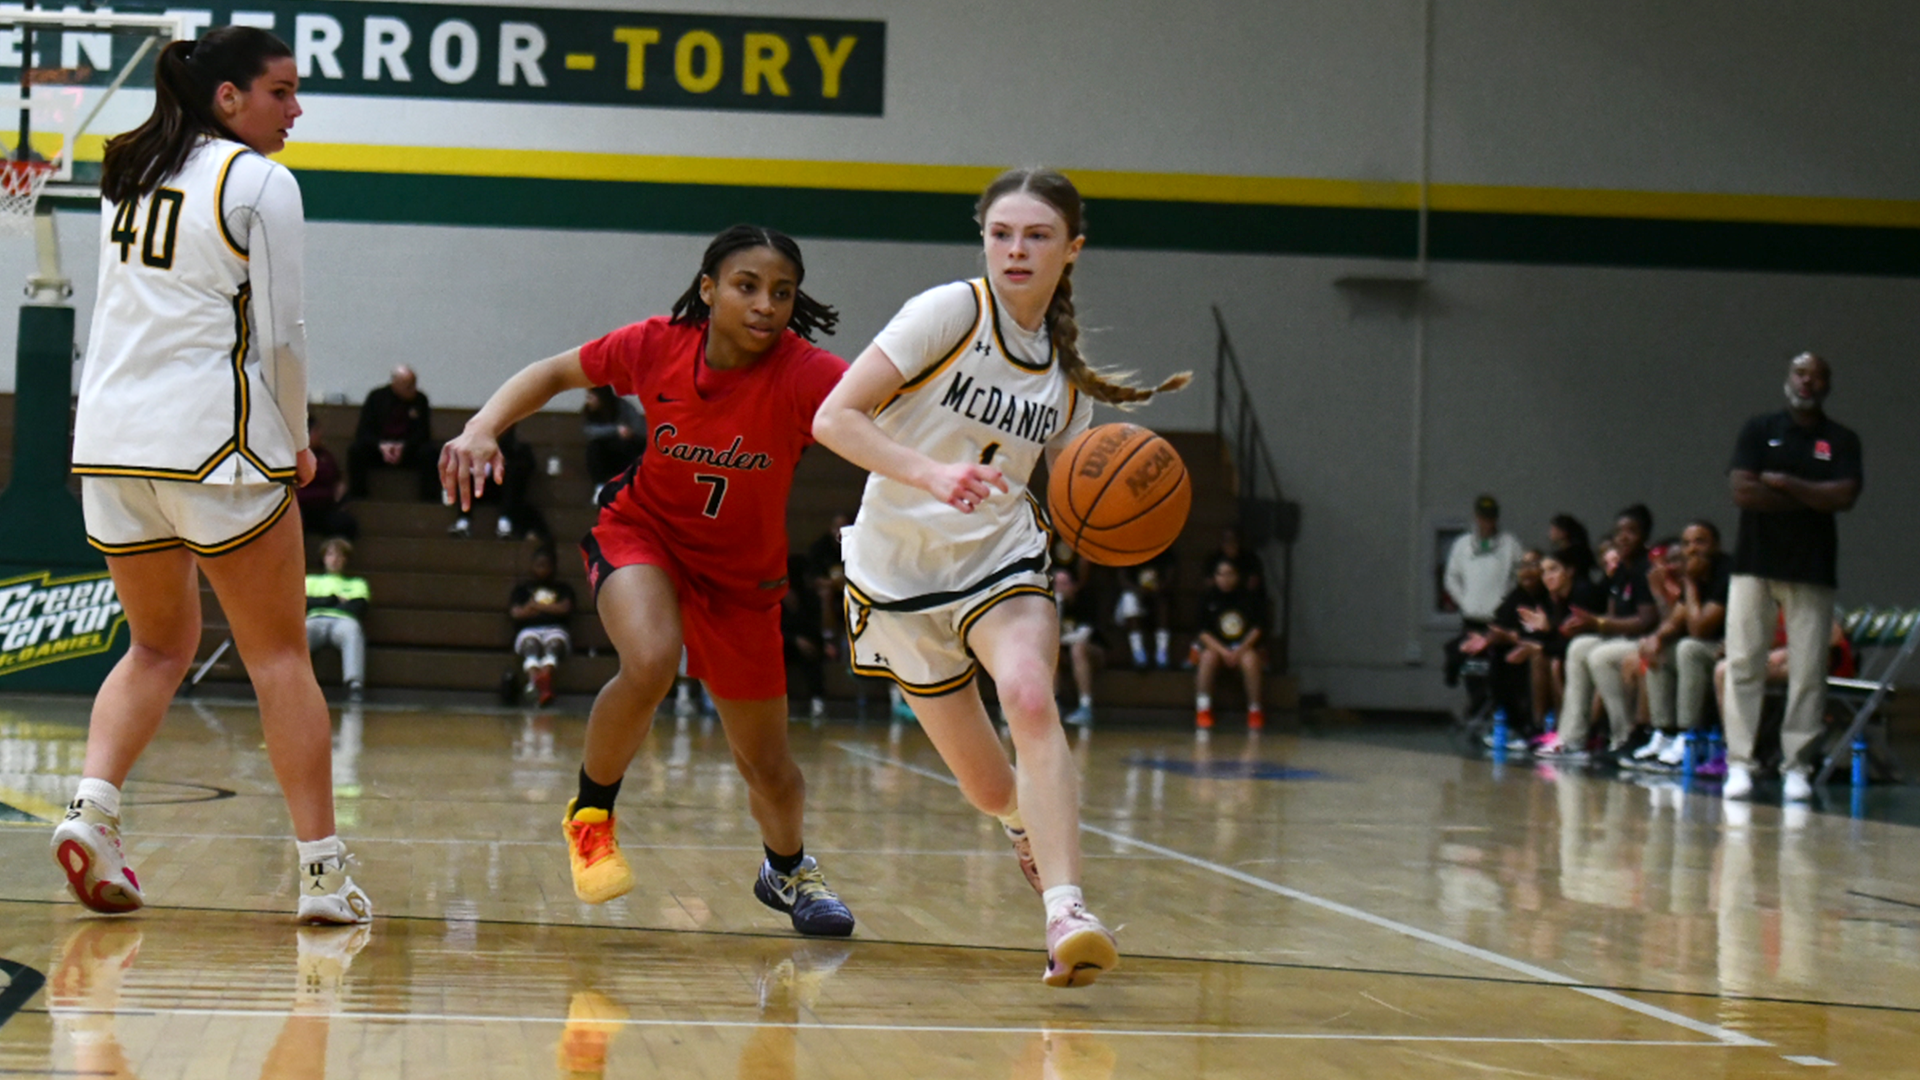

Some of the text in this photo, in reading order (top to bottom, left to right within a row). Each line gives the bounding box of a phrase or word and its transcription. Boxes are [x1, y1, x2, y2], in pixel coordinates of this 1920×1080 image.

[110, 186, 186, 271] 40
[654, 423, 773, 470] Camden
[694, 472, 729, 519] 7
